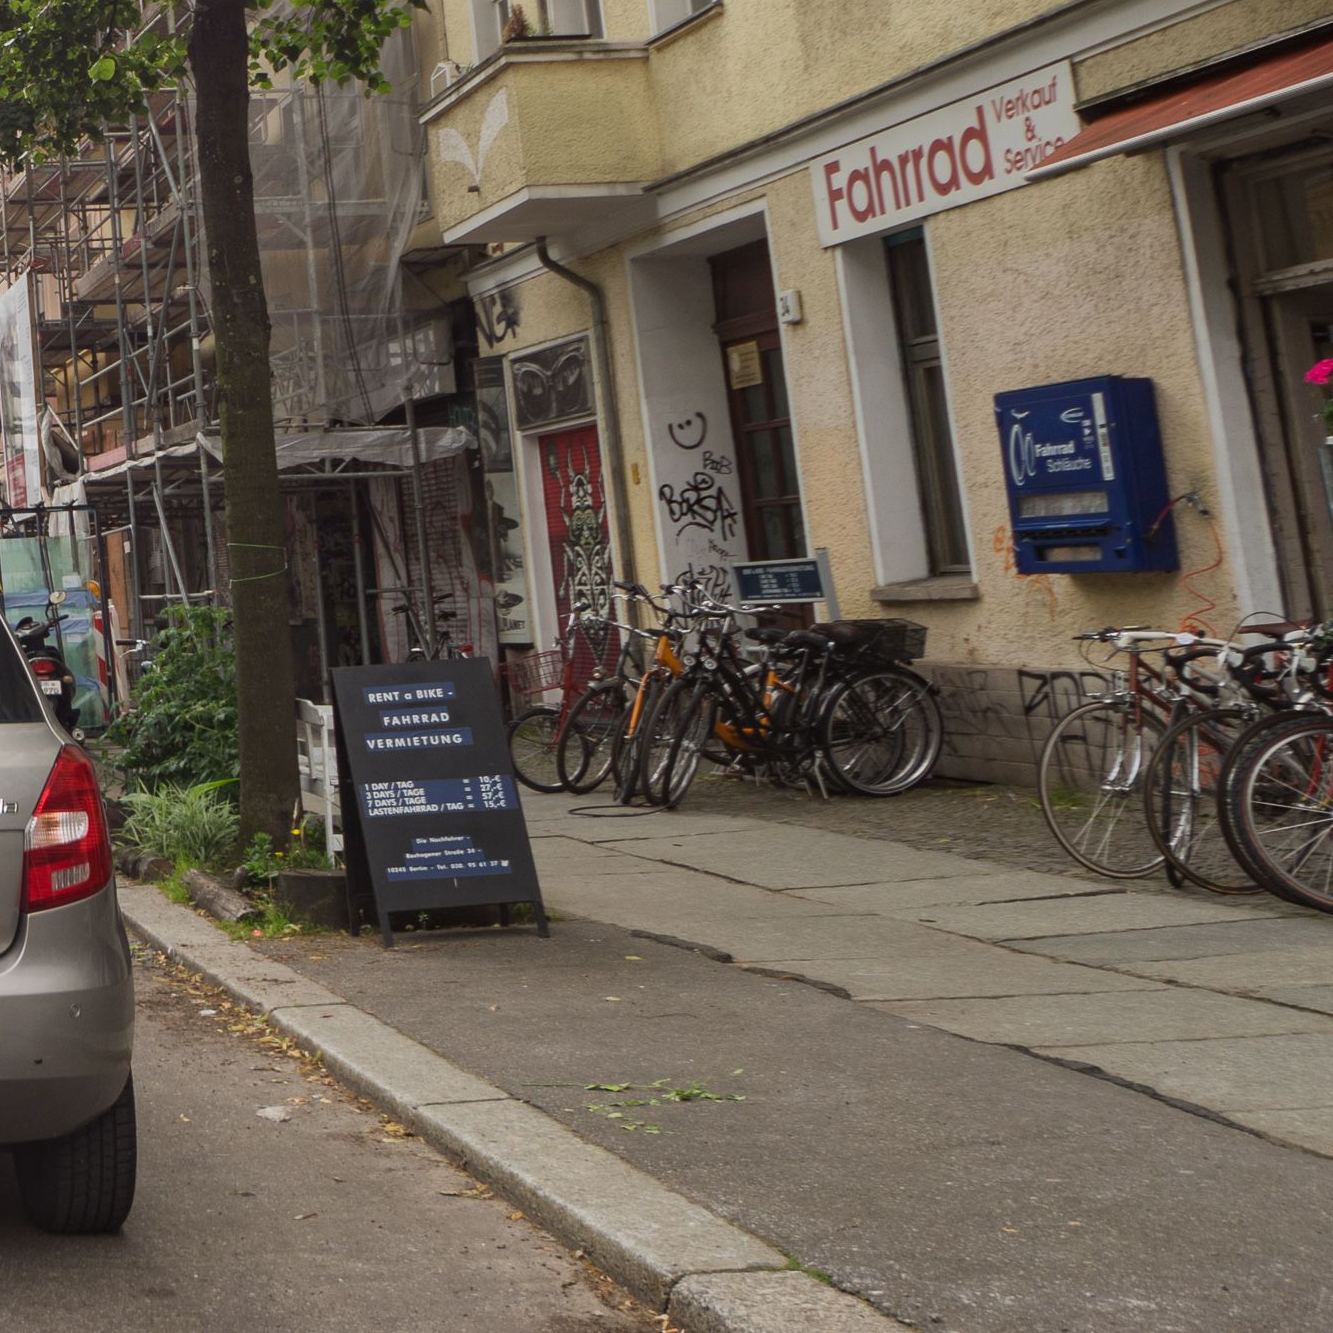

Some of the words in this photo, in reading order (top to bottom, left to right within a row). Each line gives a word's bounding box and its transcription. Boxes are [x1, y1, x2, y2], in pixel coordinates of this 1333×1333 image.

[991, 75, 1057, 123] Verkauf
[1024, 116, 1037, 142] &
[823, 105, 995, 230] Fahrrad
[1035, 440, 1075, 458] Fahrrad
[368, 691, 400, 703] RENT
[416, 688, 444, 700] BIKE
[383, 712, 450, 727] FAHRRAD
[366, 733, 463, 749] VERMIETUNG
[364, 783, 370, 791] 1
[371, 782, 390, 790] DAY
[396, 781, 414, 789] TAG
[373, 790, 395, 799] DAYS
[402, 788, 425, 797] TAGE
[367, 800, 373, 808] 7
[374, 799, 397, 807] DAYS
[403, 796, 427, 805] TAGE
[368, 804, 438, 817] LASTENFAHRRAD
[445, 802, 464, 810] TAG
